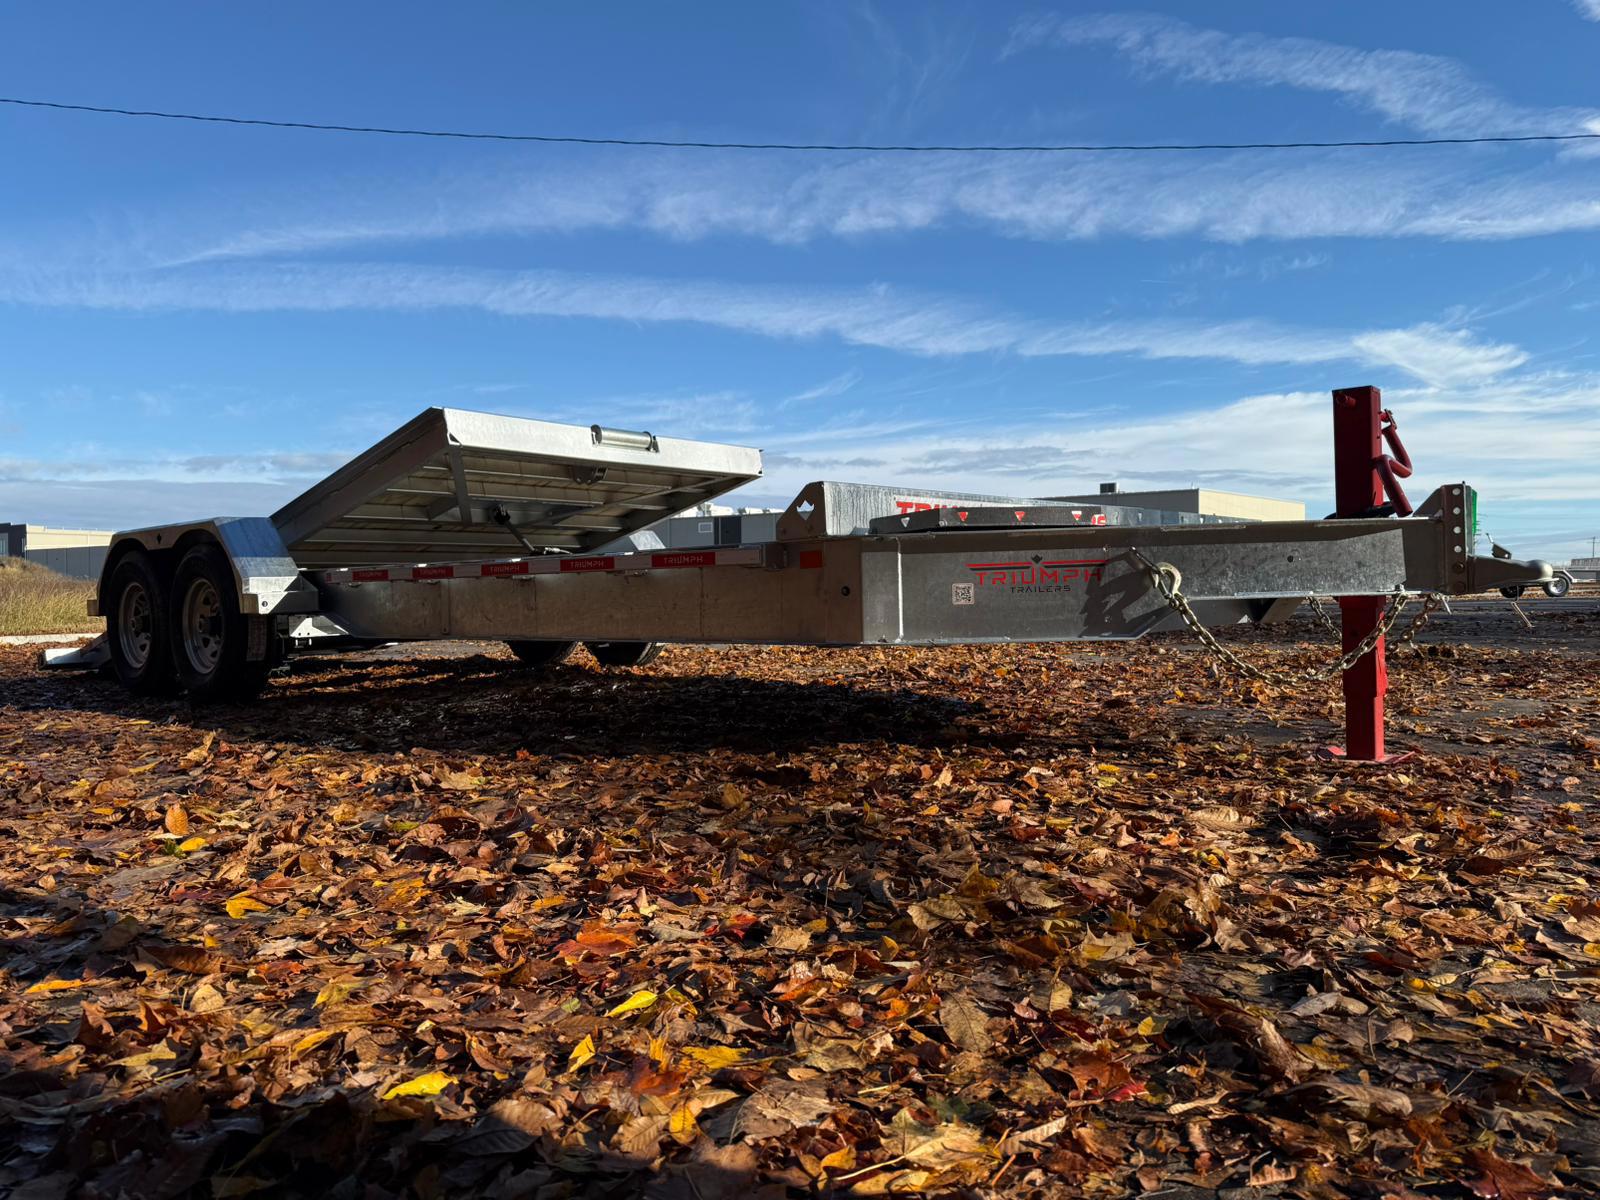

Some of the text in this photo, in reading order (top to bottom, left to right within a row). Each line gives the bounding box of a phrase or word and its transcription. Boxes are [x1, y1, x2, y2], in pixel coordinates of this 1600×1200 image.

[664, 555, 703, 564] TRIUMPH
[490, 564, 519, 572] TRIUMPH
[570, 560, 604, 569] TRIUMPH
[975, 567, 1102, 586] TRIUMPH
[1010, 584, 1071, 593] TRAILERS
